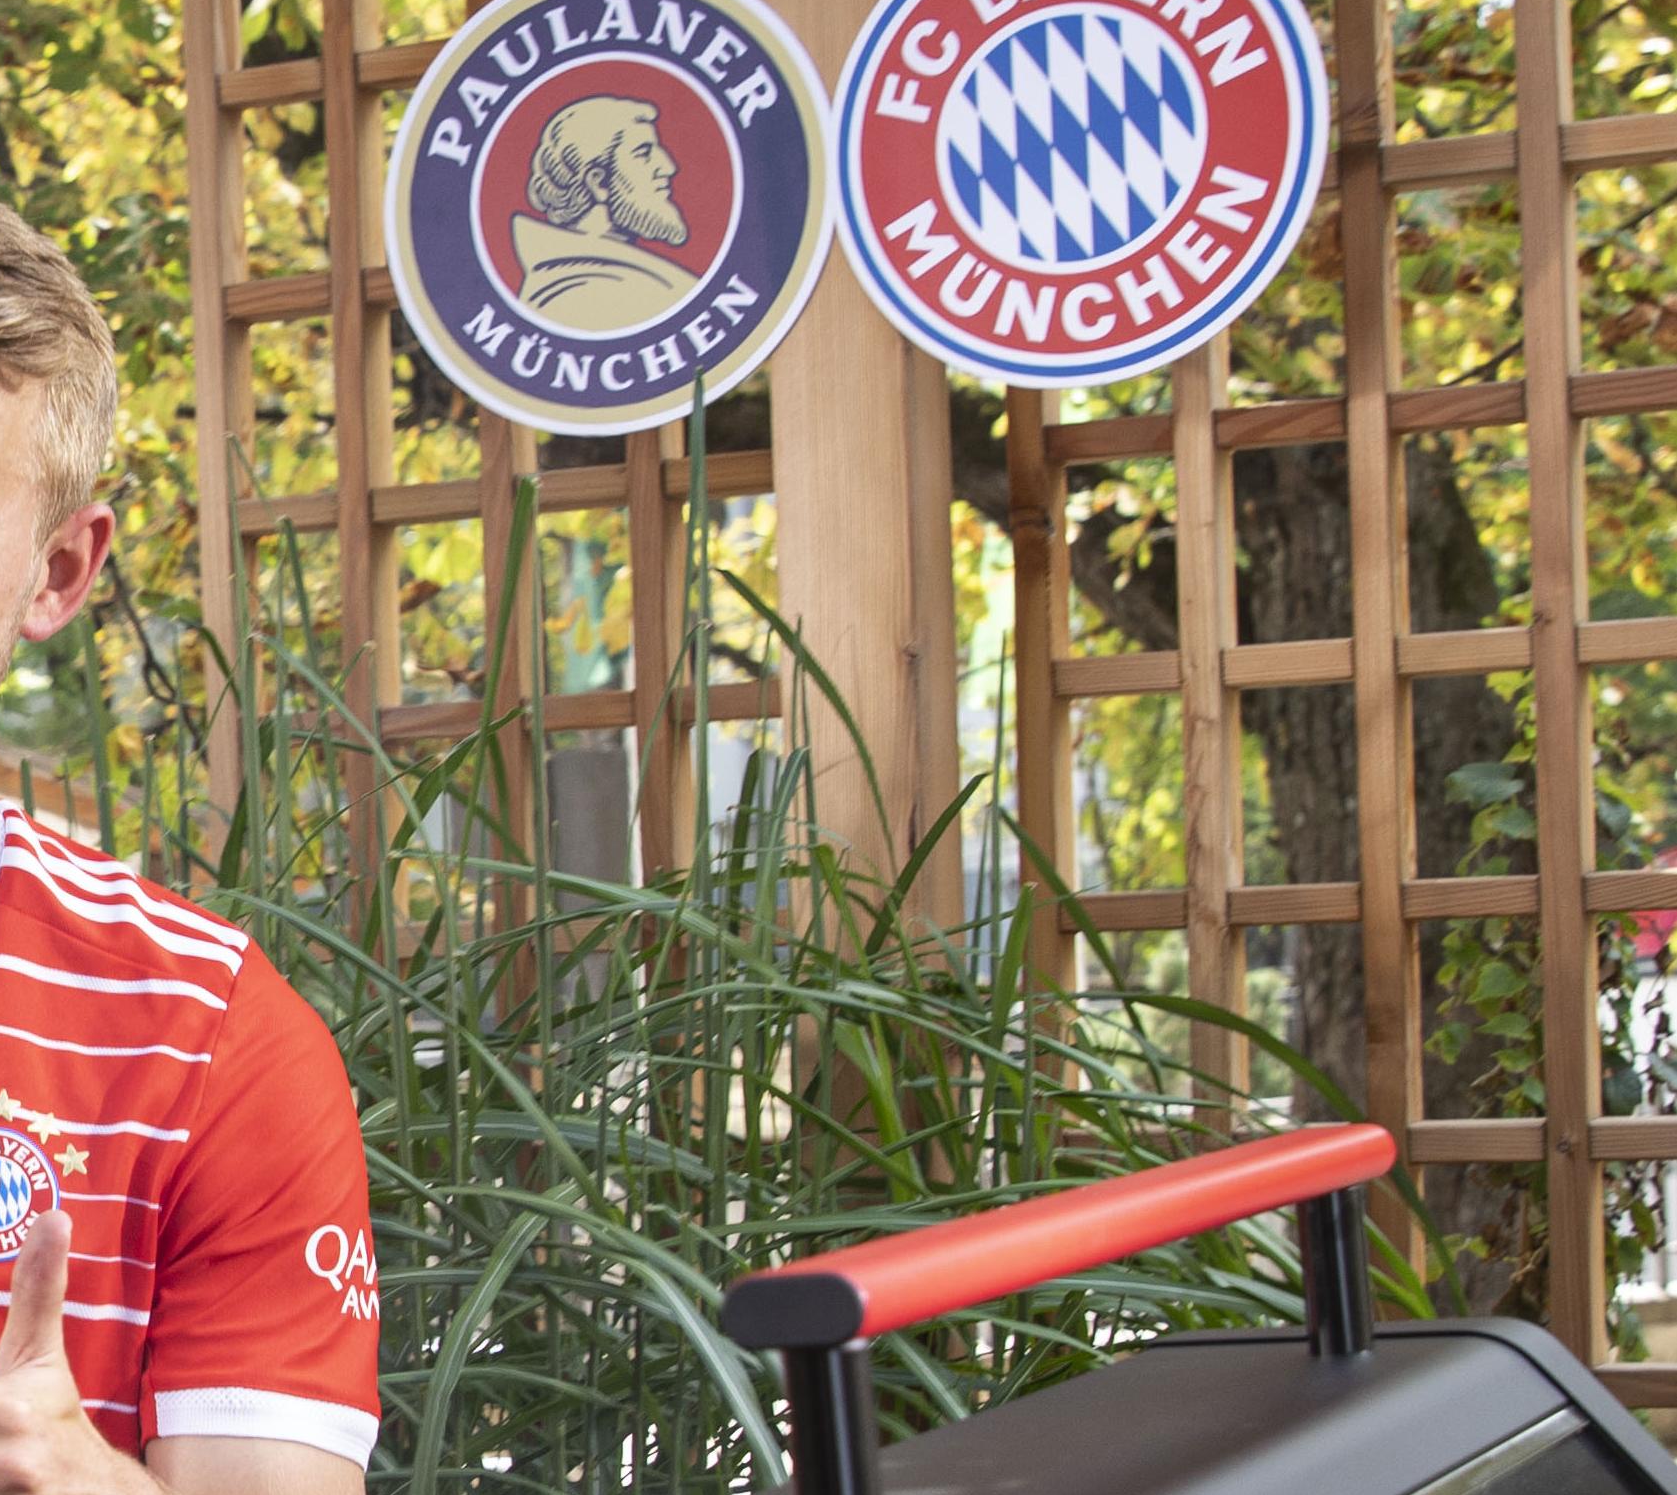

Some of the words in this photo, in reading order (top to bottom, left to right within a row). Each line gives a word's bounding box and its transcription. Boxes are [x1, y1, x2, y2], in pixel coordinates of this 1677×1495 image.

[875, 19, 961, 123] FC
[883, 165, 1270, 342] MÜNCHEN
[462, 274, 760, 392] MÜNCHEN
